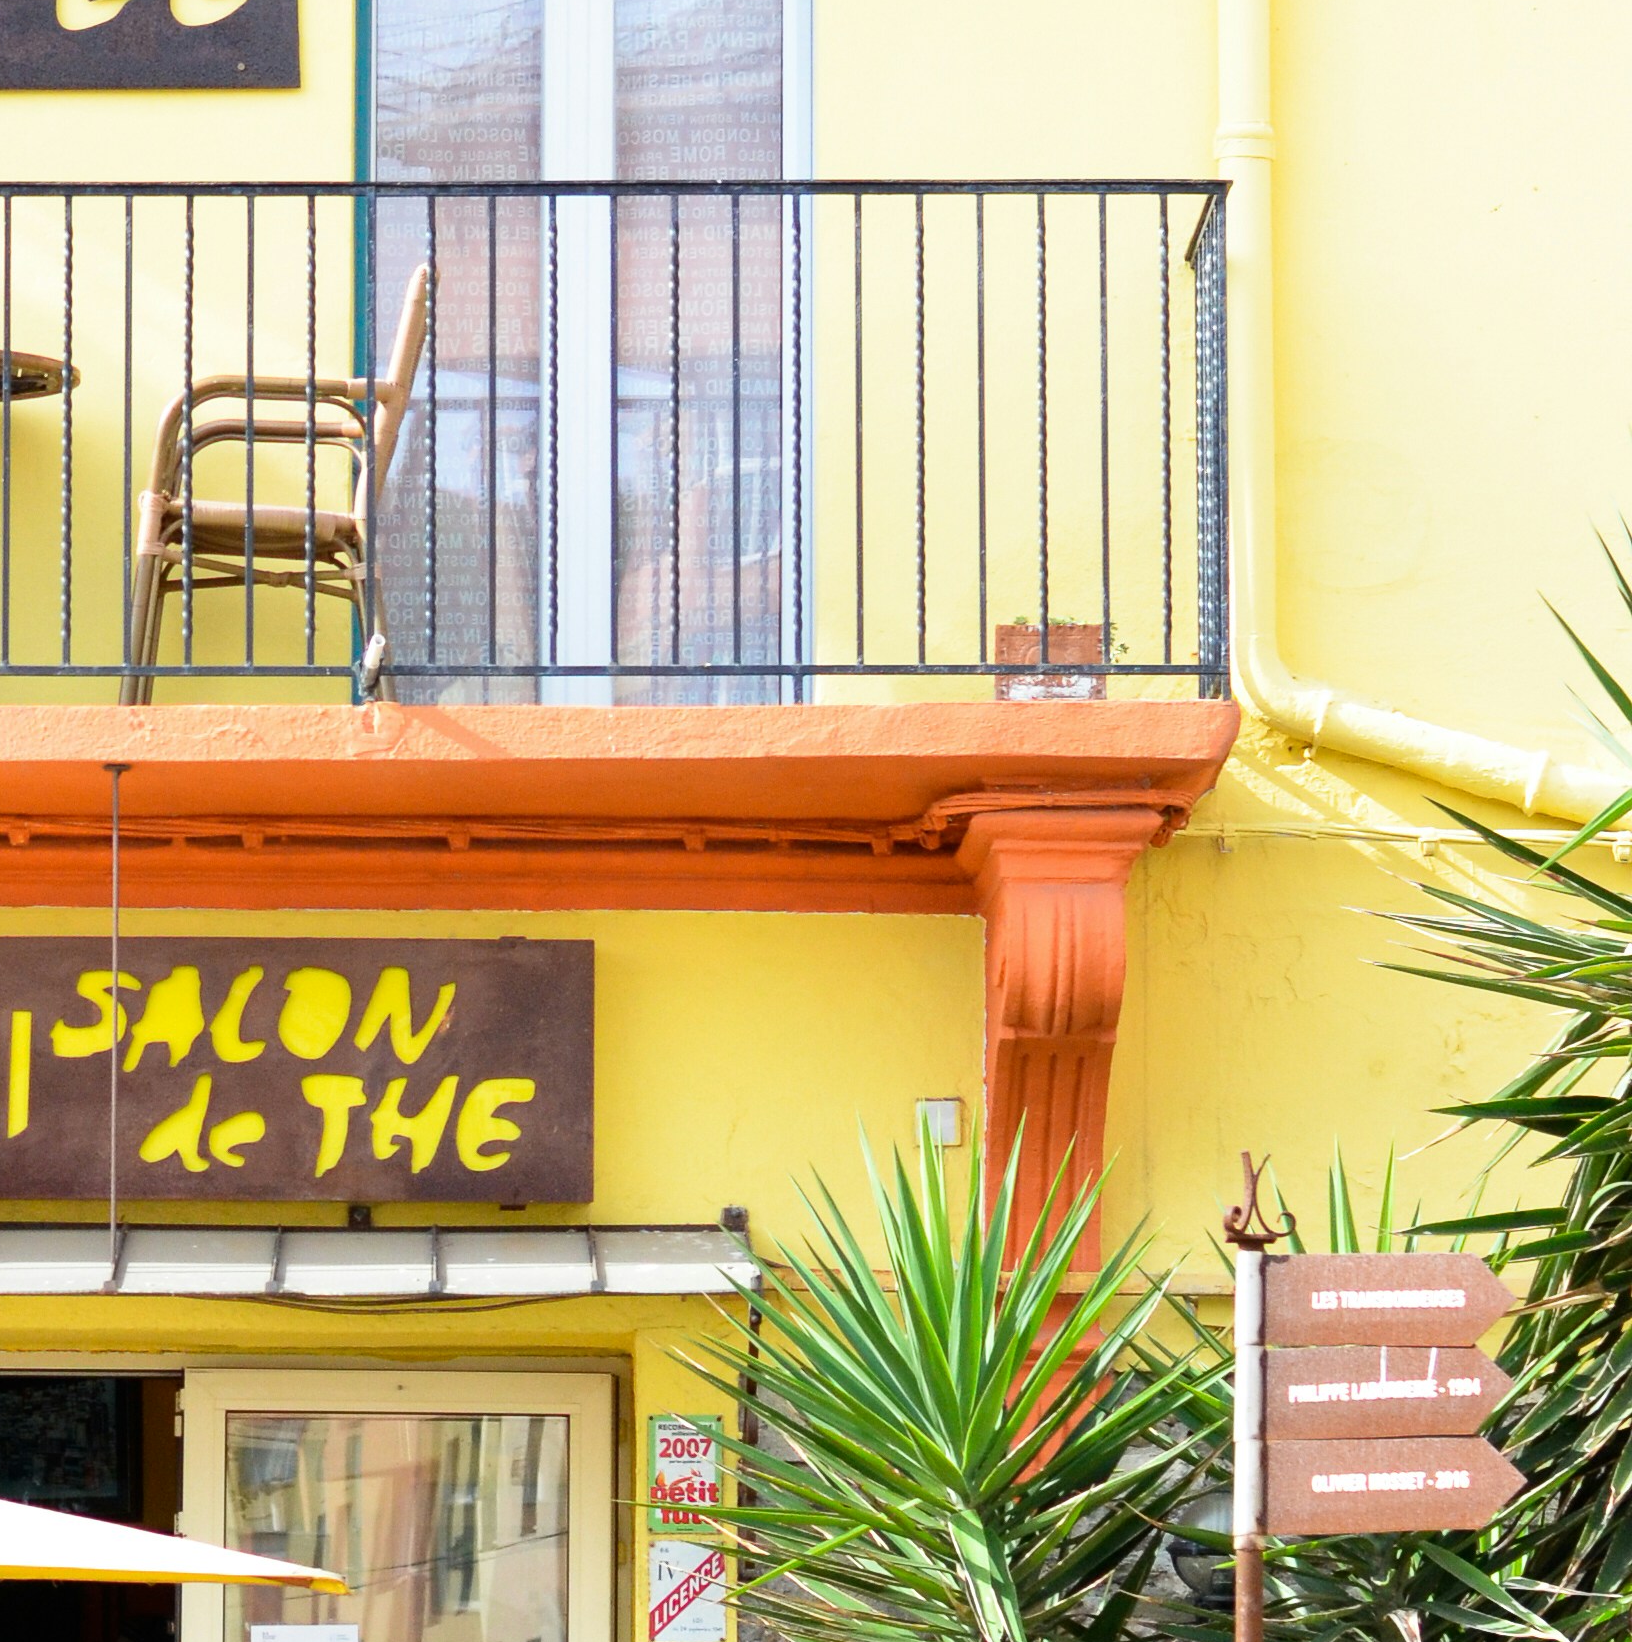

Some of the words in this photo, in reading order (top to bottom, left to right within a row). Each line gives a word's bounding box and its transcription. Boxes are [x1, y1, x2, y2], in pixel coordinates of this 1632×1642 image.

[49, 964, 458, 1070] SALON
[138, 1074, 268, 1174] de
[302, 1076, 538, 1177] THE
[1311, 1291, 1338, 1309] LES
[659, 1438, 713, 1458] 2007
[650, 1481, 719, 1505] petit
[1311, 1474, 1367, 1492] OLIVIER
[654, 1552, 721, 1632] LICENCE
